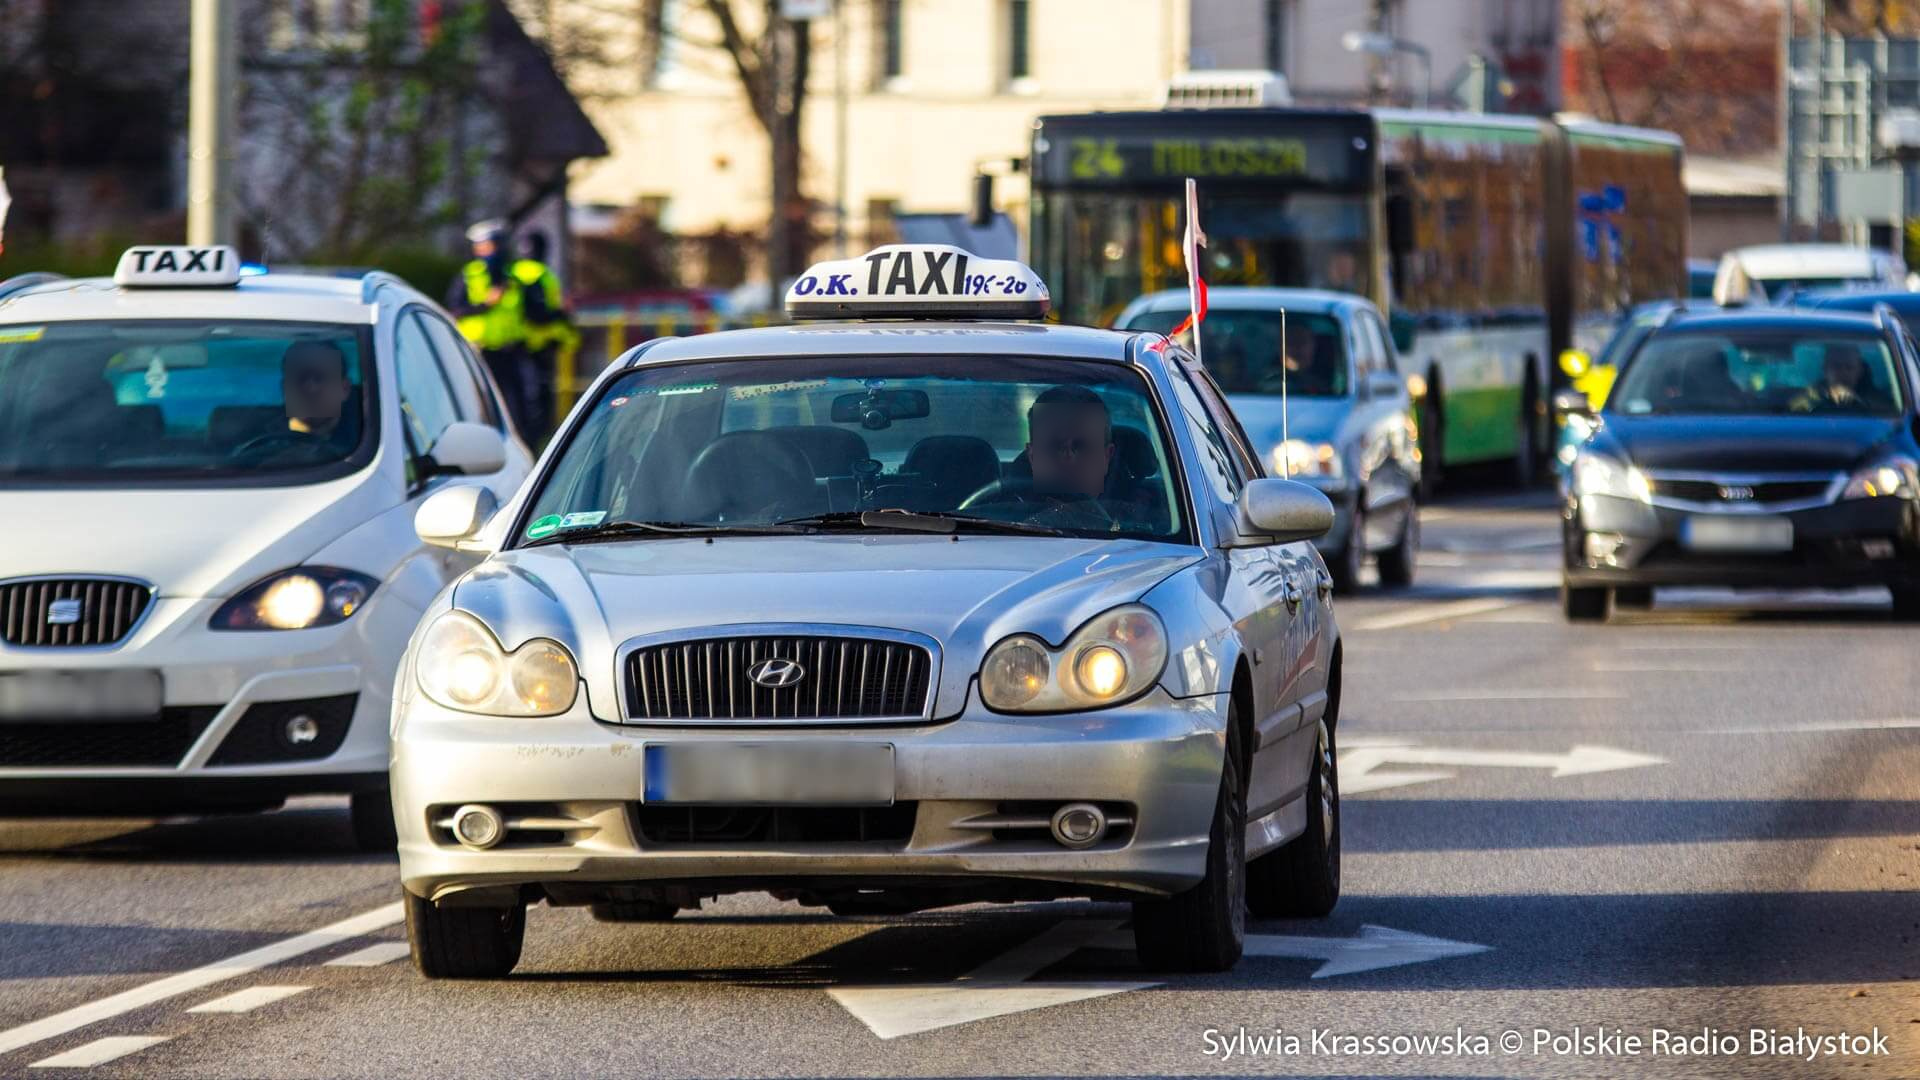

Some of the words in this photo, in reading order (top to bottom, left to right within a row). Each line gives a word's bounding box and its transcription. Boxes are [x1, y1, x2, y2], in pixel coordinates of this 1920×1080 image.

[1072, 138, 1124, 178] 24
[131, 250, 225, 272] TAXI
[795, 275, 858, 296] O.K.
[866, 252, 968, 295] TAXI
